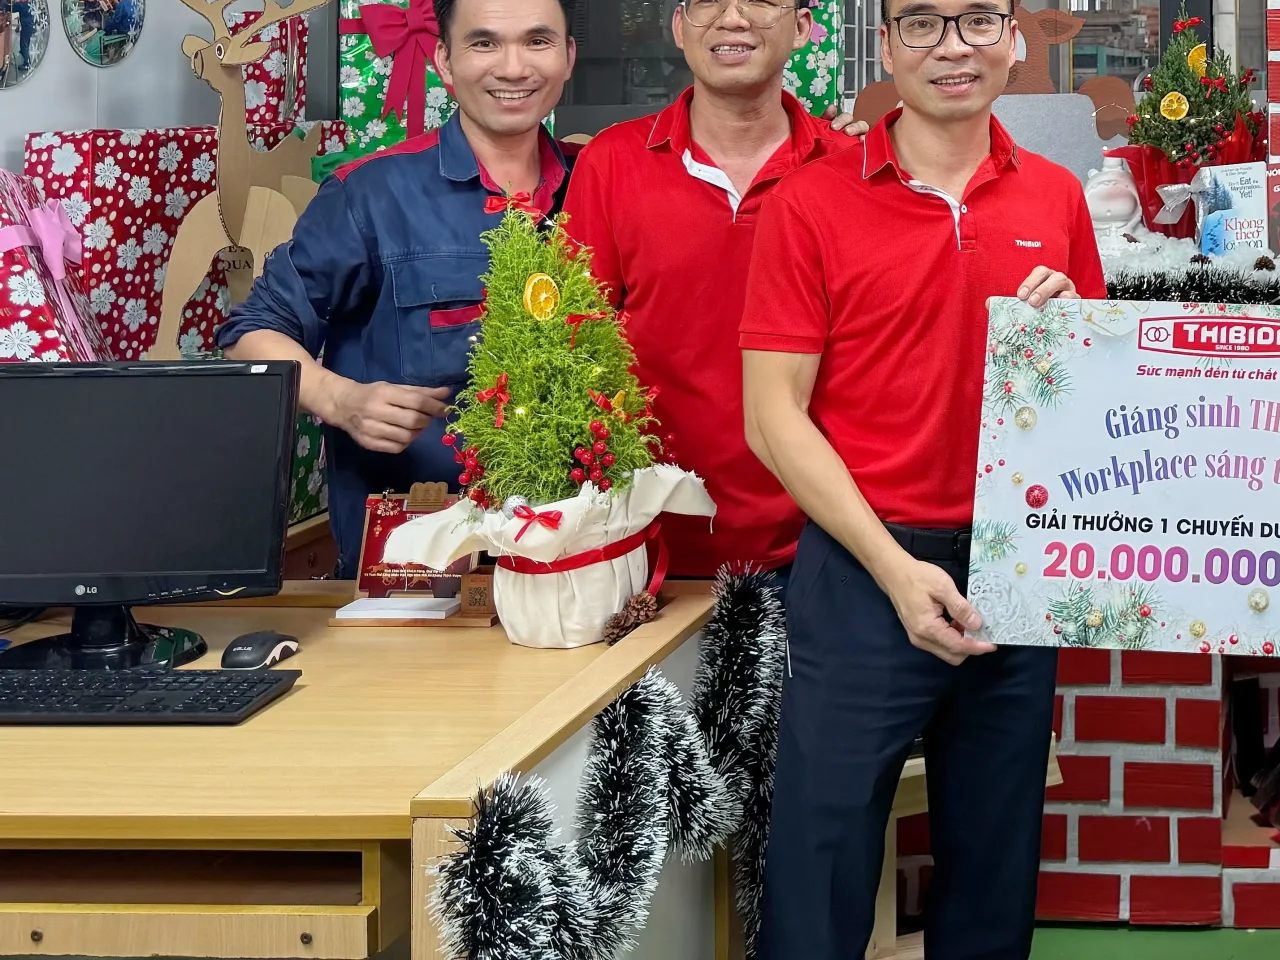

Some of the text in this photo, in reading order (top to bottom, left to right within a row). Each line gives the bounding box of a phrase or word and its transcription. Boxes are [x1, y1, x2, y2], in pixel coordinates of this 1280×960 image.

[1239, 177, 1252, 186] Eat
[1239, 190, 1253, 199] Yet!
[1225, 217, 1265, 233] Không
[1136, 364, 1163, 377] Sức
[1164, 366, 1202, 379] mạnh
[1204, 365, 1230, 380] đến
[1233, 368, 1246, 380] từ
[1247, 367, 1278, 381] chất
[1105, 404, 1180, 440] Giáng
[1186, 395, 1241, 428] sinh
[1058, 449, 1198, 502] Workplace
[1204, 449, 1267, 492] sáng
[1025, 508, 1067, 530] GIẢI
[1072, 510, 1154, 533] THƯỞNG
[1160, 518, 1168, 534] 1
[1176, 514, 1254, 538] CHUYẾN
[86, 586, 98, 594] LG
